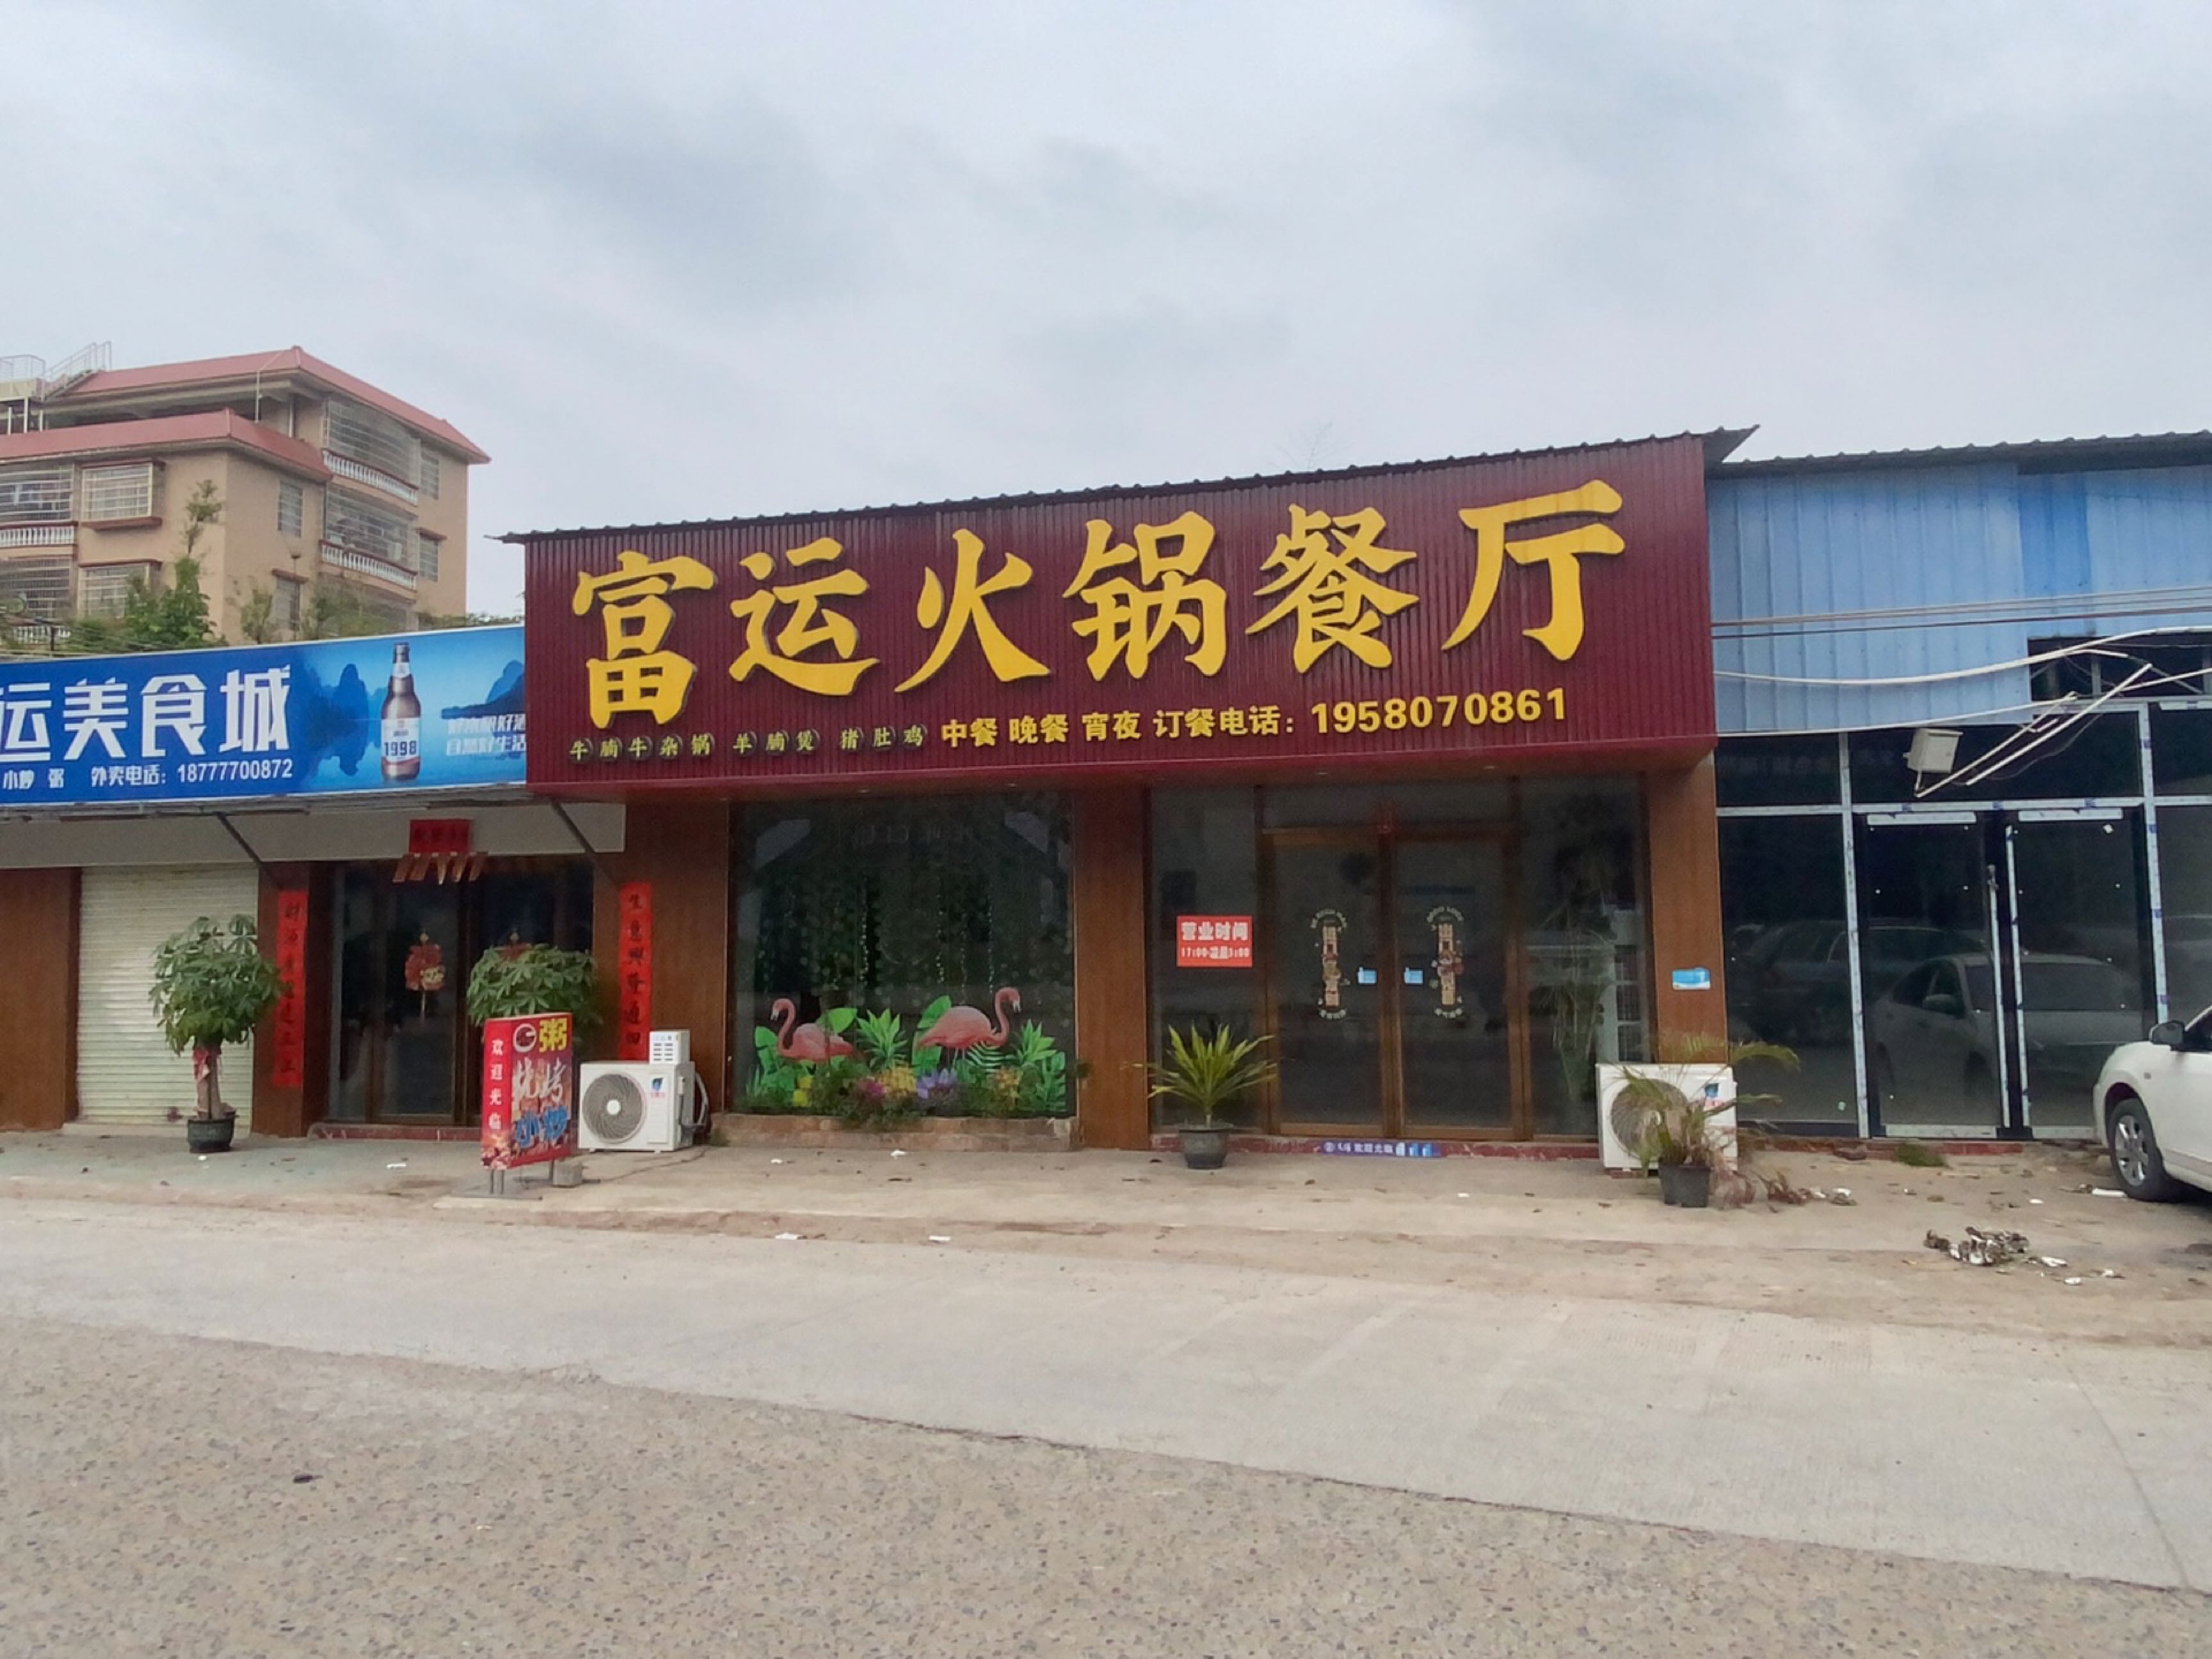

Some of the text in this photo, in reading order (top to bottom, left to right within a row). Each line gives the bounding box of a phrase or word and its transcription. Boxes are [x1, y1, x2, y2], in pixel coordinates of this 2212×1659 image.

[572, 480, 1625, 726] 富运火锅餐厅
[0, 663, 292, 762] 运美食城
[840, 725, 924, 749] 猪肚鸡
[941, 719, 998, 748] 中餐
[1009, 714, 1069, 744] 晚餐
[1081, 710, 1142, 741] 宵夜
[1153, 705, 1294, 738] 订餐电话：
[1311, 687, 1566, 733] 1958070861
[384, 741, 417, 756] 1998
[3, 770, 35, 790] 小炒
[92, 764, 166, 787] 外卖电话：
[178, 758, 293, 783] 18777700872
[1181, 921, 1249, 941] 营业时间
[538, 1018, 568, 1053] 粥
[488, 1038, 503, 1130] 欢迎光临
[513, 1056, 566, 1107] 烧烤
[515, 1105, 569, 1148] 小炒
